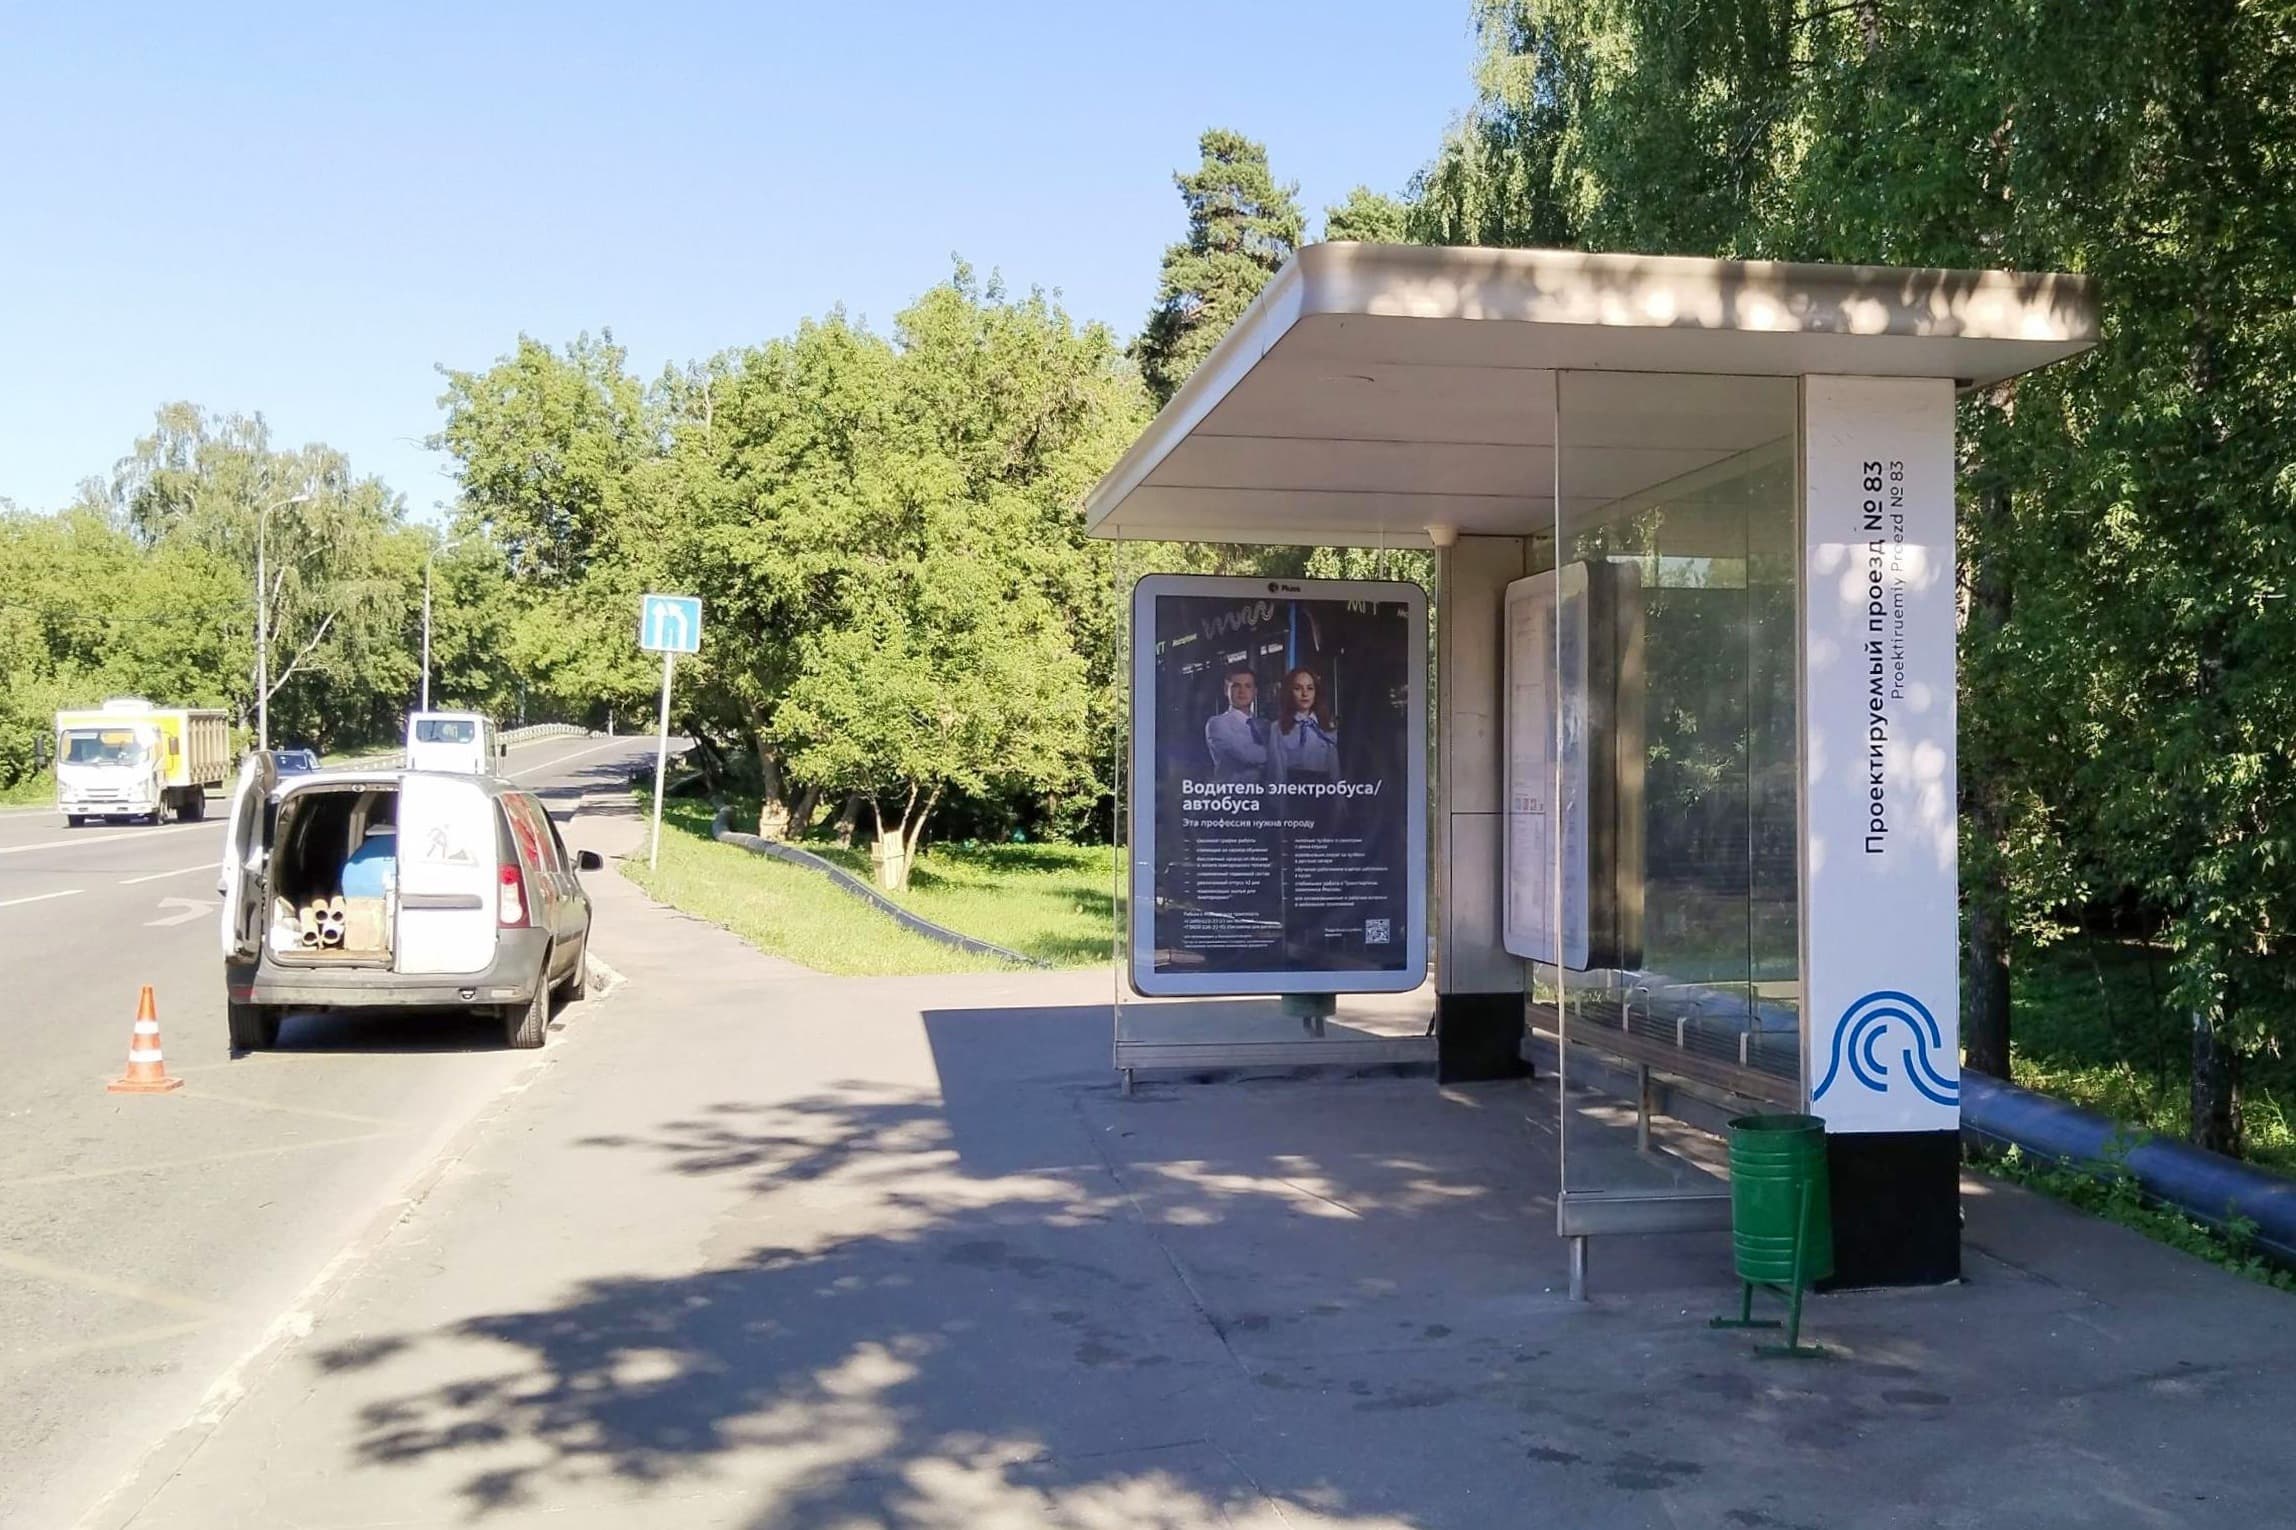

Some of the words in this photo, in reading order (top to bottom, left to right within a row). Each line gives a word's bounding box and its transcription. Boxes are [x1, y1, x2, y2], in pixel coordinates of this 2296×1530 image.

[1863, 461, 1883, 492] 83
[1890, 460, 1904, 482] 83
[1890, 486, 1904, 507] №
[1863, 500, 1883, 530] №
[1889, 513, 1904, 571] Proezd
[1868, 539, 1888, 632] проезд
[1890, 577, 1907, 699] Proektiruemiy
[1863, 640, 1889, 853] Проектируемый
[1182, 779, 1265, 798] Водитель
[1268, 779, 1383, 799] электробуса/
[1182, 795, 1261, 815] автобуса
[1182, 817, 1200, 828] Эта
[1201, 817, 1251, 829] профессия
[1253, 818, 1283, 829] нужна
[1284, 819, 1316, 830] городу
